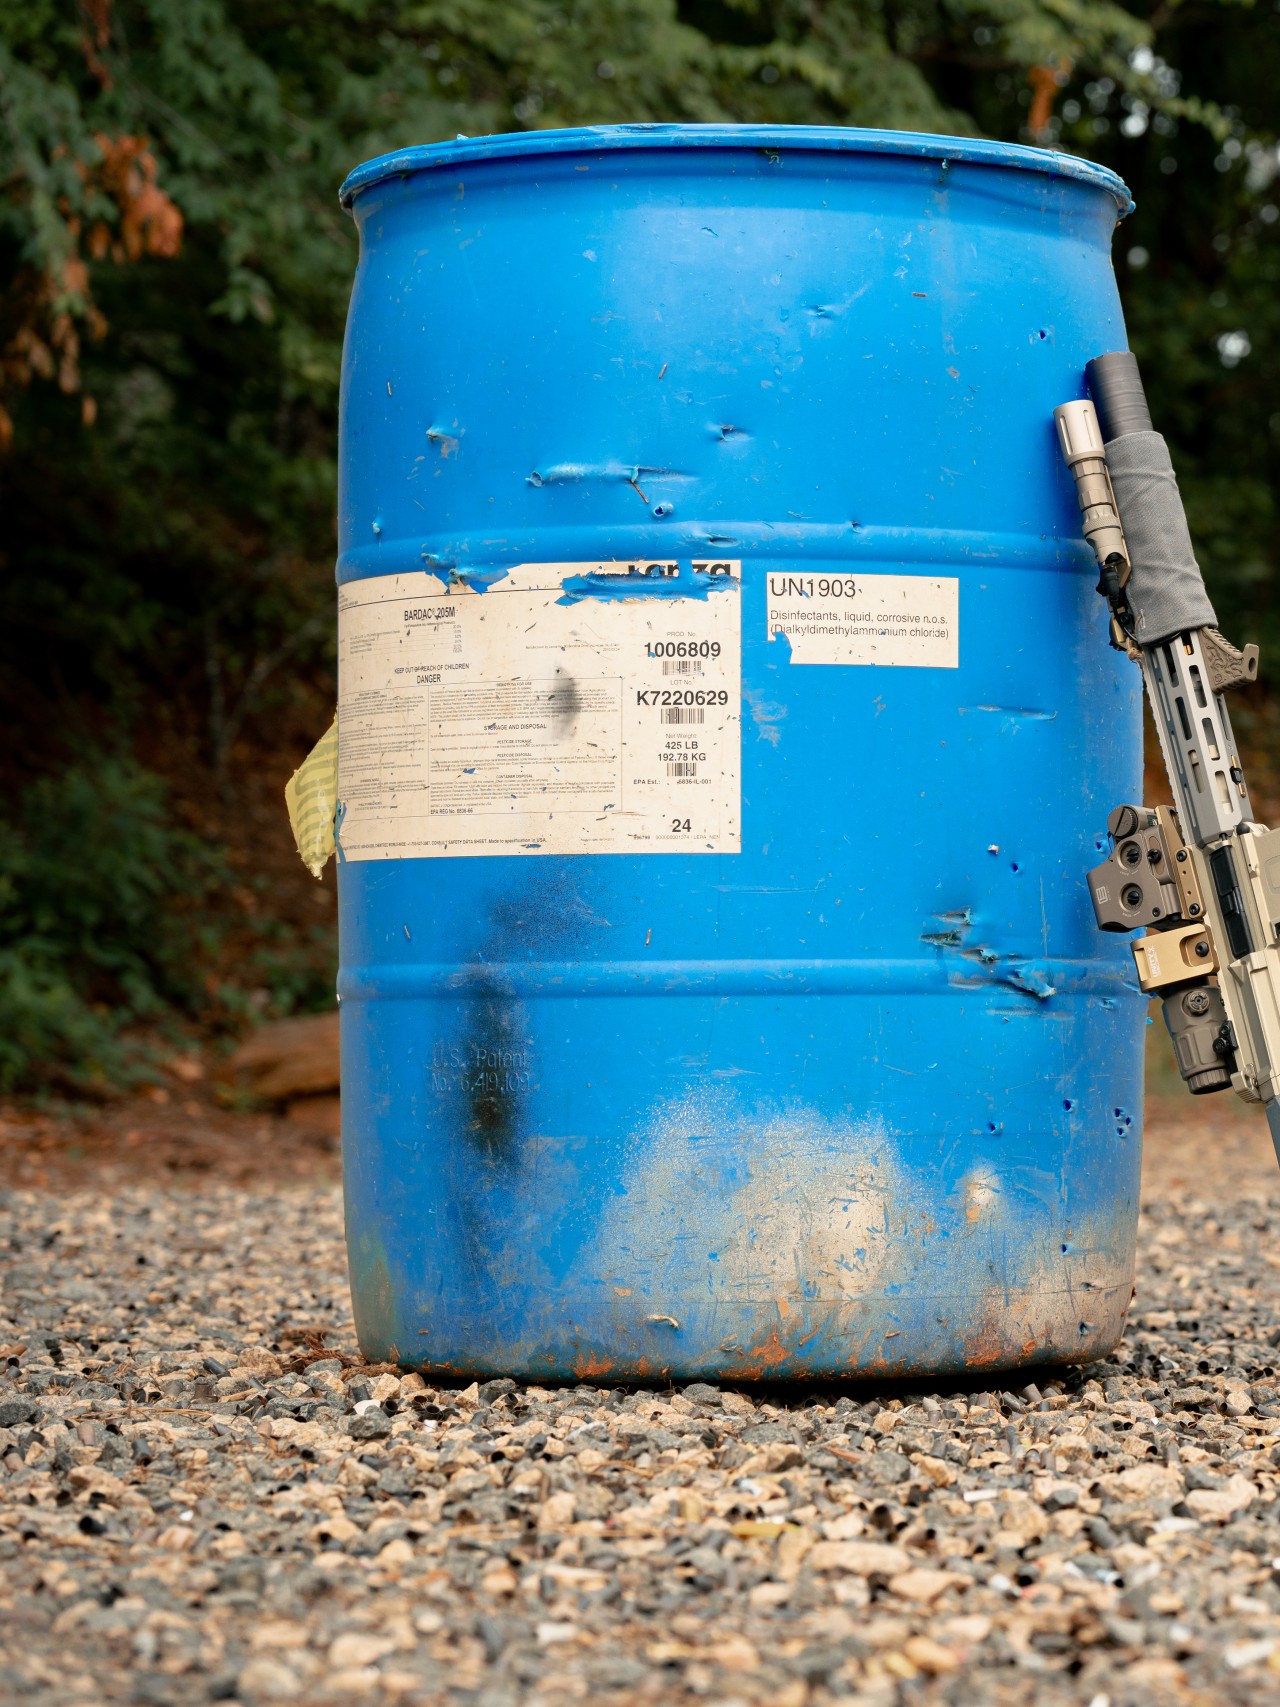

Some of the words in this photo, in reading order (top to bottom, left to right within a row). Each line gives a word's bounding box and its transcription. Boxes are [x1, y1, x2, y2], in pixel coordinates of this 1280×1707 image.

[770, 577, 856, 598] UN1903
[437, 606, 456, 620] 205M
[770, 610, 841, 622] Disinfectants,
[844, 611, 874, 624] liquid,
[877, 613, 920, 623] corrosive
[909, 627, 949, 639] chloride)
[644, 642, 721, 658] 1006809
[444, 663, 470, 671] CHILDREN
[416, 674, 441, 684] DANGER
[636, 690, 729, 706] K7220629
[665, 741, 682, 750] 425
[685, 741, 699, 750] LB
[658, 753, 688, 761] 192.78
[691, 753, 707, 761] KG
[671, 818, 692, 833] 24
[476, 1048, 528, 1068] Patent
[432, 1072, 451, 1091] No.
